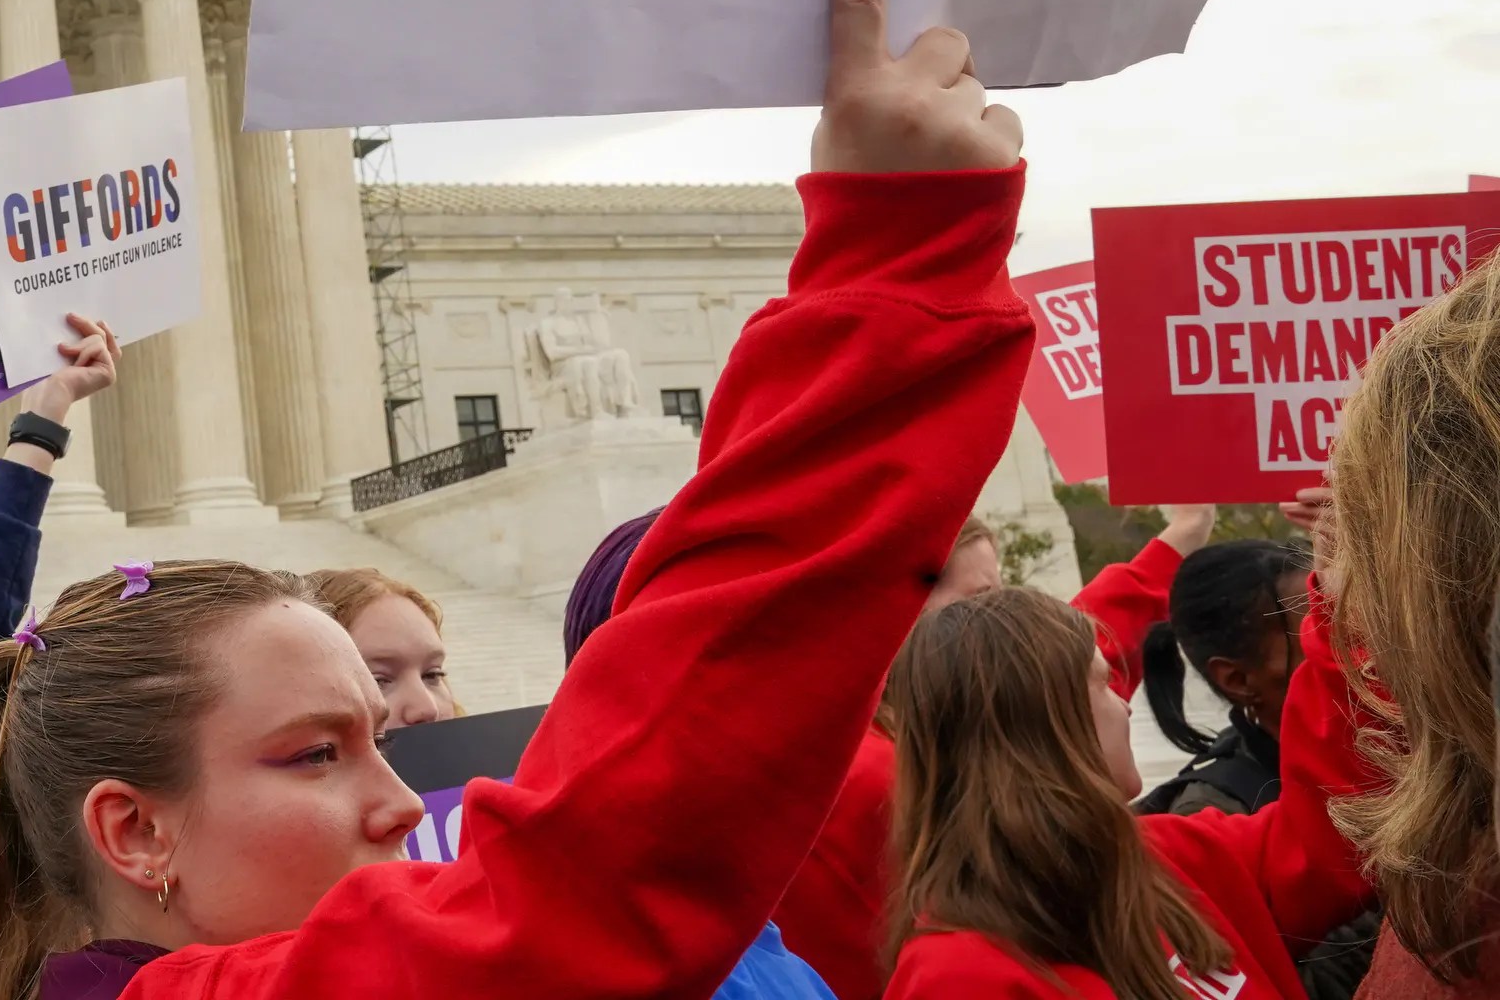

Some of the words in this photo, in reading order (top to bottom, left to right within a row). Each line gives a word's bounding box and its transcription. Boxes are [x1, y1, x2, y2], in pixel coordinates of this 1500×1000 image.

[2, 157, 182, 264] GIFFORDS
[14, 265, 72, 295] COURAGE
[73, 261, 90, 280] TO
[92, 252, 121, 275] FIGHT
[122, 246, 141, 265] GUN
[141, 232, 183, 259] VIOLENCE
[1202, 233, 1464, 309] STUDENTS
[1045, 288, 1100, 337] ST
[1050, 342, 1103, 393] DE
[1266, 397, 1344, 463] AC
